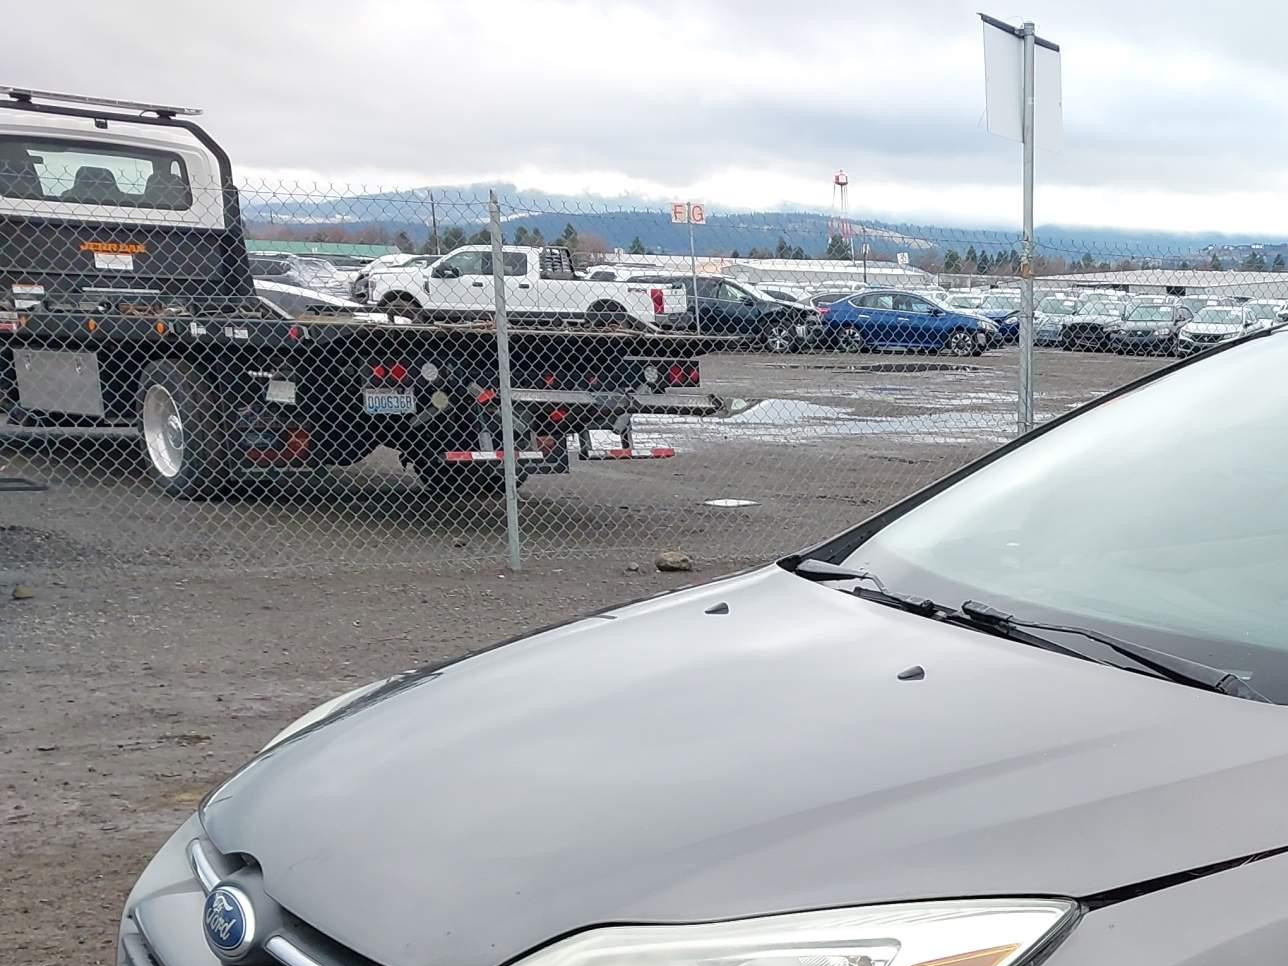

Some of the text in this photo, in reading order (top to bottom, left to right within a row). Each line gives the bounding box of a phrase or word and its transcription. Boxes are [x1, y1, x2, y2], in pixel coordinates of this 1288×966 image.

[674, 204, 683, 221] F
[692, 205, 704, 222] G
[206, 893, 236, 940] Ford
